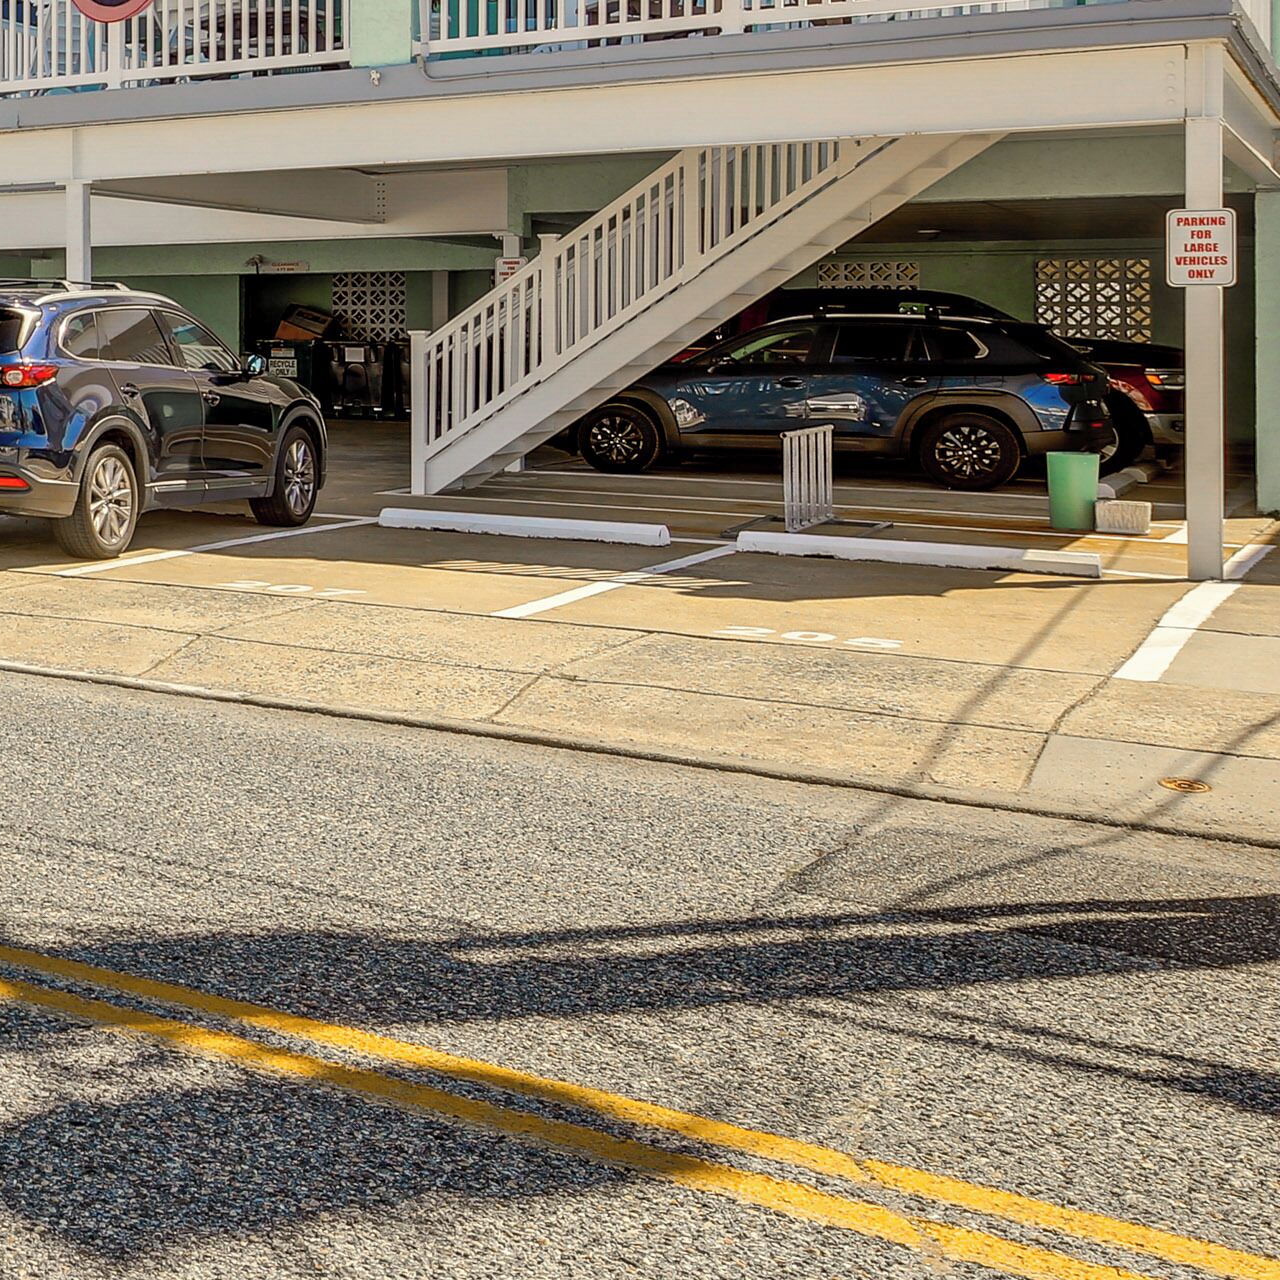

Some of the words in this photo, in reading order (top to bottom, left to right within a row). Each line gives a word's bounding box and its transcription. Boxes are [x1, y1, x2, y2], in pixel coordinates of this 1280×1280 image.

[1176, 216, 1226, 227] PARKING
[1190, 229, 1212, 239] FOR
[1184, 243, 1219, 253] LARGE
[1175, 255, 1228, 266] VEHICLES
[1187, 269, 1216, 279] ONLY
[270, 360, 296, 368] RECYCLE
[275, 368, 289, 376] ONLY
[215, 579, 368, 596] 207
[713, 625, 905, 648] 205
